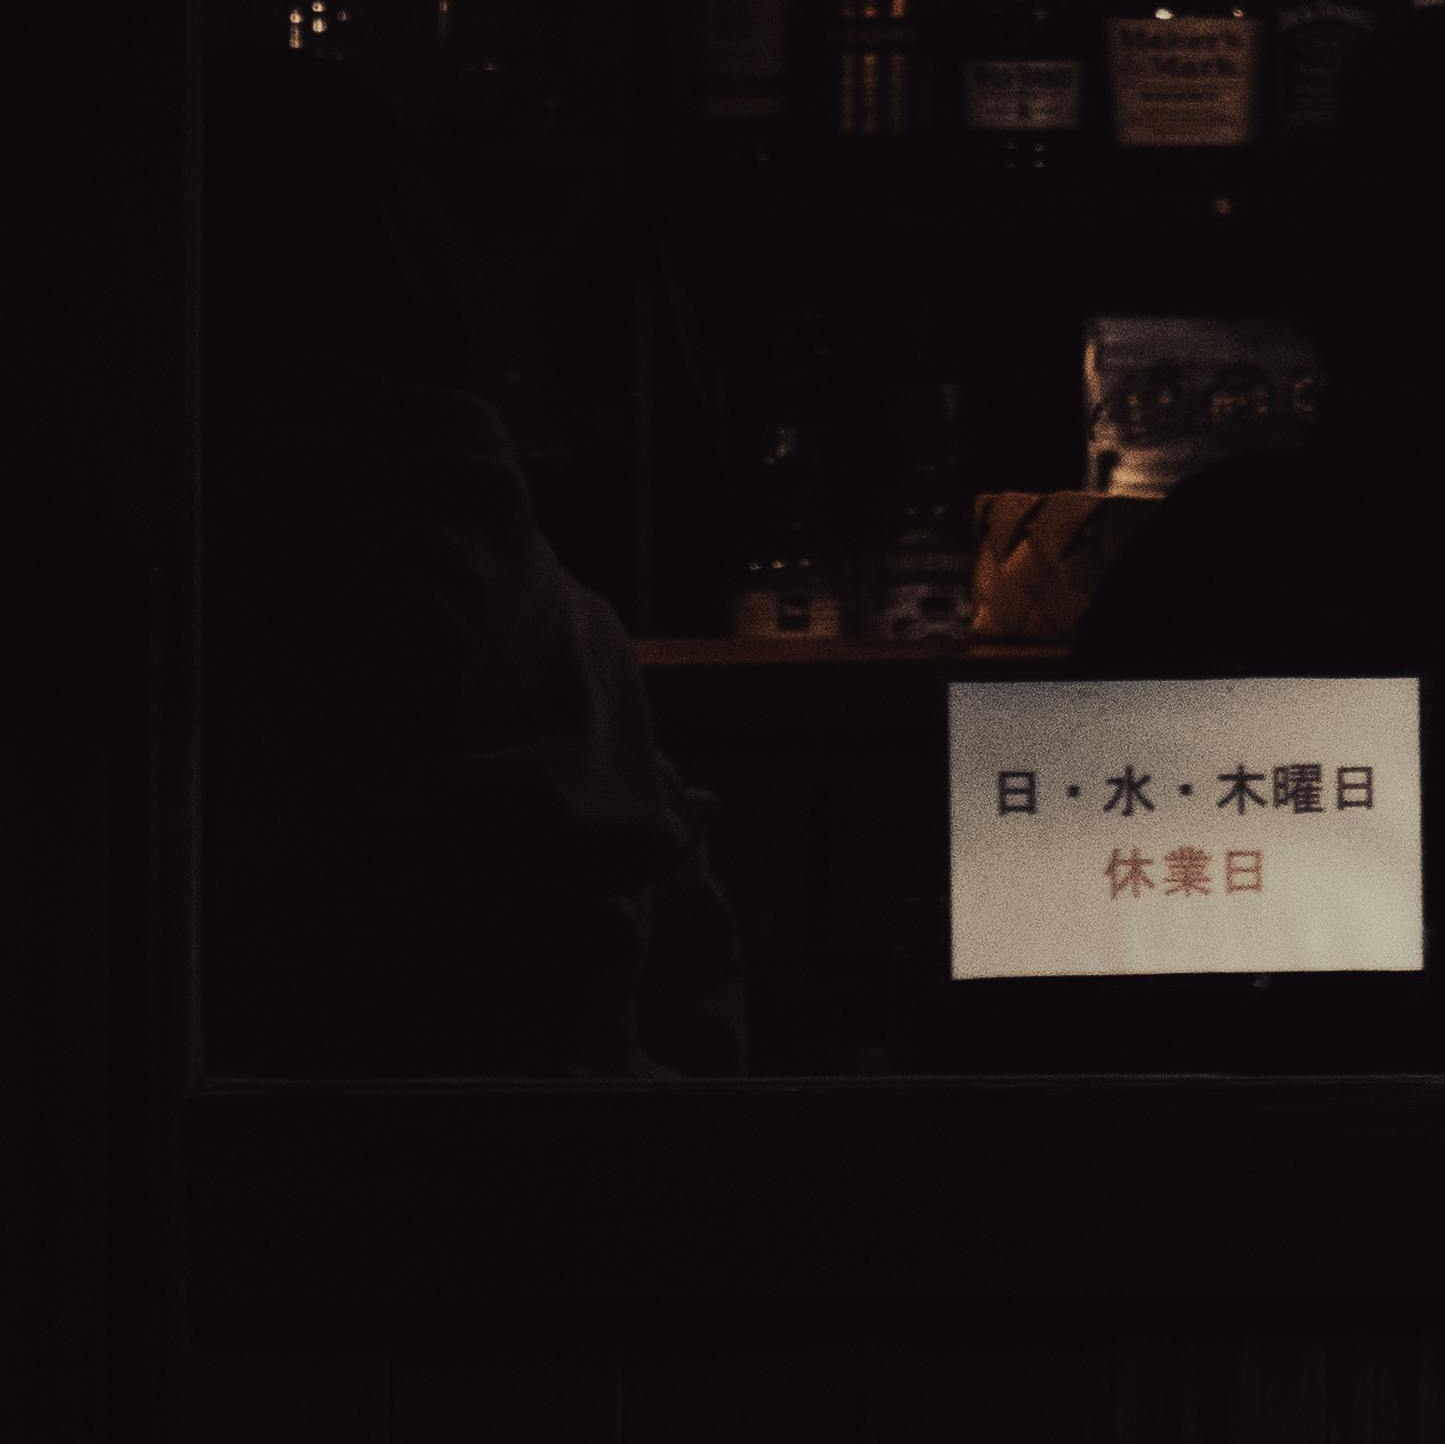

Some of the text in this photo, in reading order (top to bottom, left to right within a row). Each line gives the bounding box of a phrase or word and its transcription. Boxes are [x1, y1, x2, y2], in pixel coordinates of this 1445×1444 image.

[996, 763, 1375, 816] 日・水・木曜日
[1105, 846, 1265, 899] 休業日
